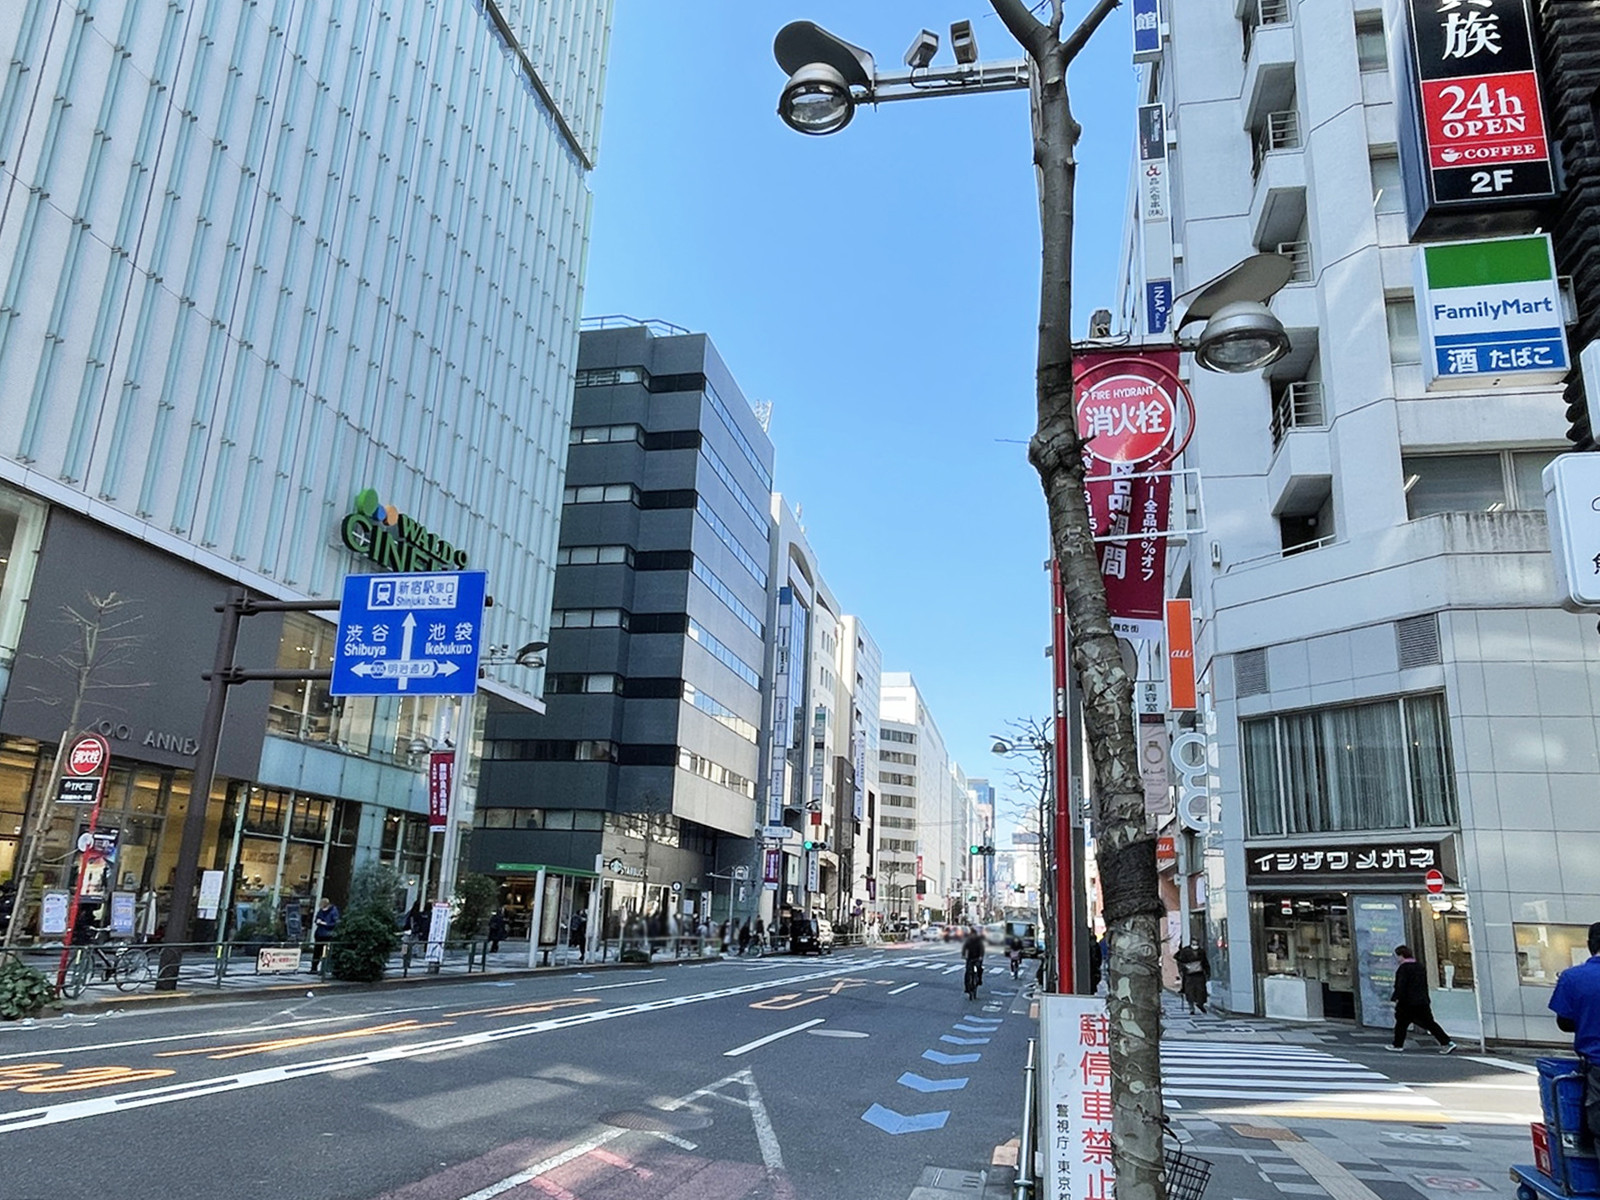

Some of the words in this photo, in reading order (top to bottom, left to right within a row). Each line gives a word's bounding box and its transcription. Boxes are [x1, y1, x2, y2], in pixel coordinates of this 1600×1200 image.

[1437, 0, 1502, 60] 族
[1439, 83, 1524, 120] 24h
[1443, 116, 1526, 138] OPEN
[1464, 144, 1536, 159] COFFEE
[1470, 169, 1513, 193] 2F
[1434, 297, 1553, 320] FamilyMart
[1447, 348, 1479, 373] 酒
[1489, 346, 1553, 368] たばこ
[1091, 390, 1110, 400] FIRE
[1113, 386, 1154, 399] HYDRANT
[1085, 400, 1166, 437] 消火栓
[341, 513, 446, 572] CINE
[398, 513, 455, 565] WALD
[398, 580, 454, 596] 新宿駅東口
[396, 595, 425, 608] Shinjuku
[345, 624, 390, 643] 渋谷
[427, 622, 474, 642] 池袋
[344, 643, 387, 657] Shibuya
[424, 642, 473, 656] Ikebukuro
[1170, 649, 1193, 658] au
[387, 663, 430, 675] 明治通り
[1078, 1013, 1117, 1200] 駐停車禁止
